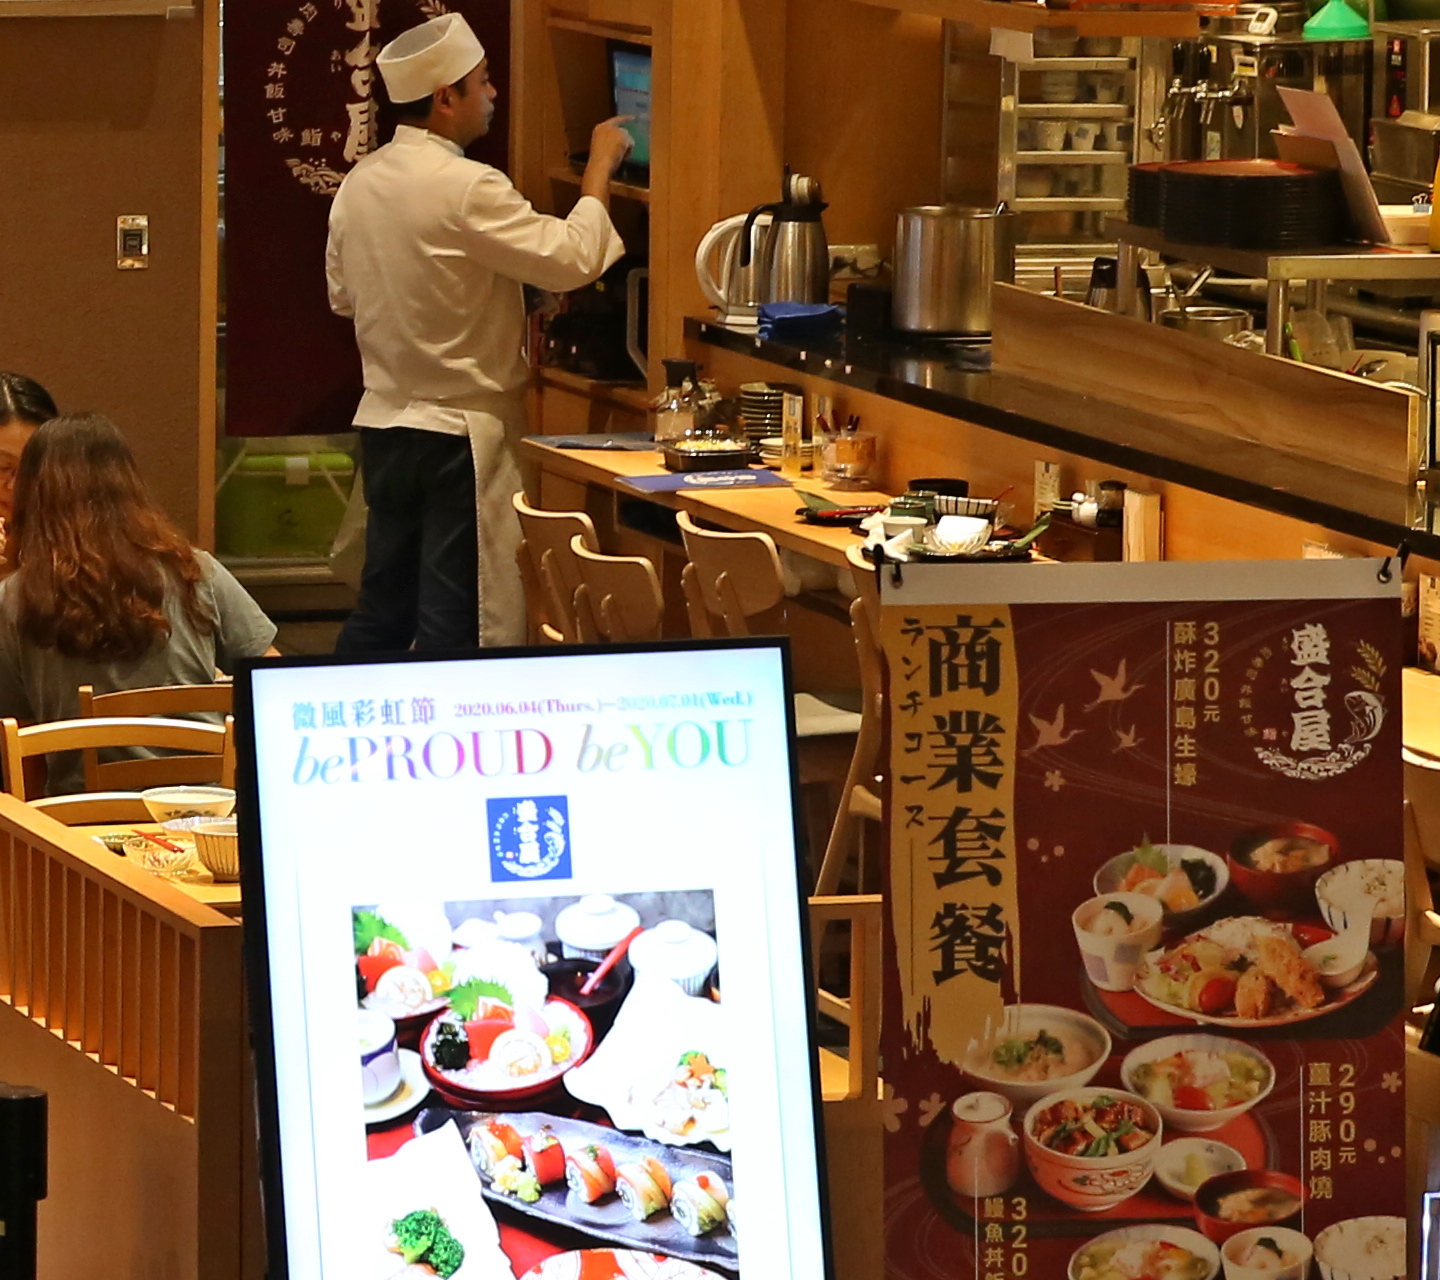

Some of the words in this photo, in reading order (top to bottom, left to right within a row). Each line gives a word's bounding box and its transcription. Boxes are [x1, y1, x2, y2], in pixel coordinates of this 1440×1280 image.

[292, 696, 436, 731] 微風彩虹節
[1203, 621, 1220, 722] 320元
[1290, 622, 1332, 752] 盛合屋
[291, 727, 554, 786] bePROUD
[576, 718, 754, 774] beYOU
[899, 617, 926, 828] ランチコース
[927, 614, 1006, 987] 商業套餐
[1338, 1063, 1357, 1164] 290元
